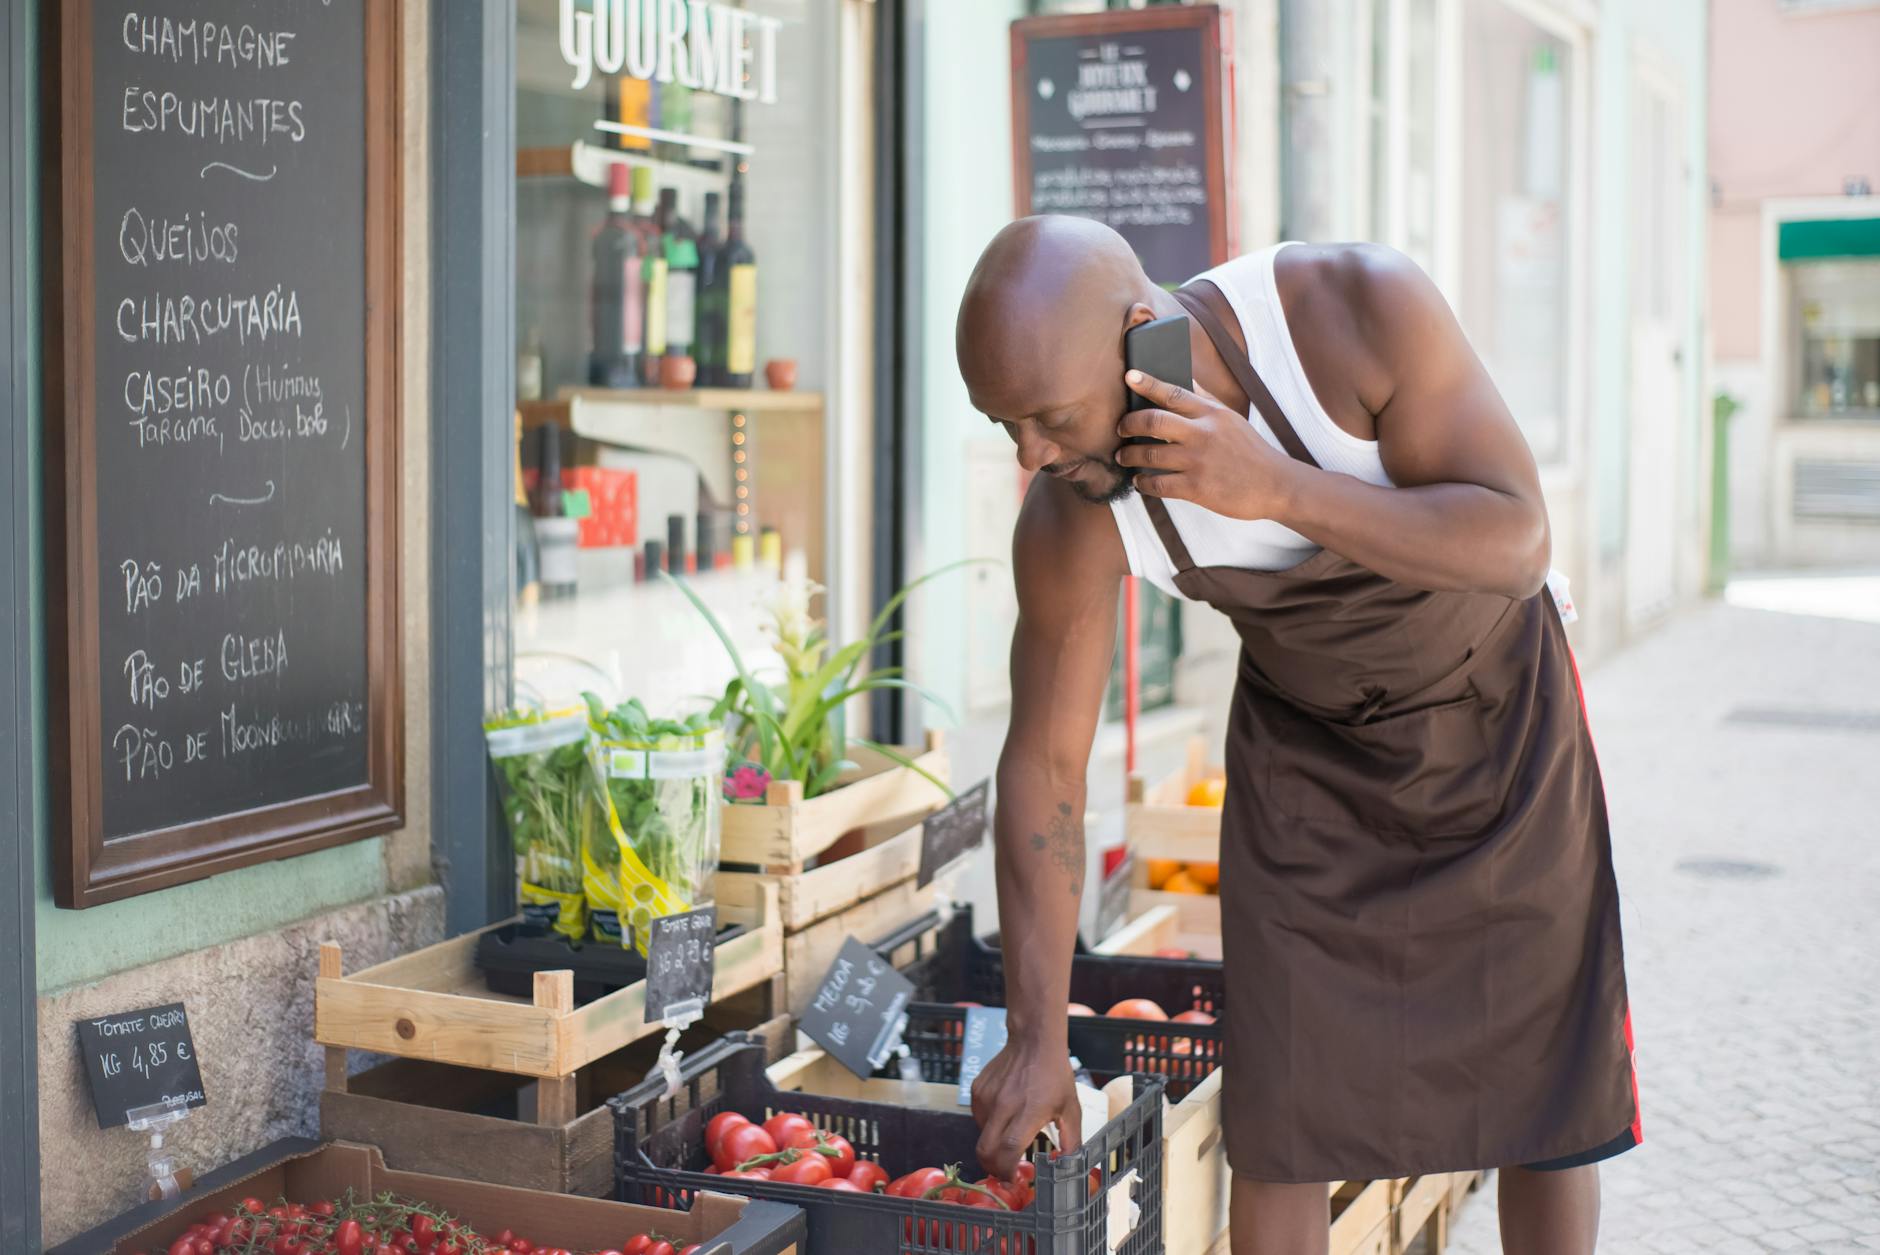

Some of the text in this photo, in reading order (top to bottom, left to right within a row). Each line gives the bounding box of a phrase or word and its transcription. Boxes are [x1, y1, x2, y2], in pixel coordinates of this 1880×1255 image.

[123, 12, 296, 68] CHAMPAGNE
[123, 87, 305, 145] ESPUMANTES
[176, 563, 200, 602] DA
[178, 658, 205, 694] DE
[113, 723, 173, 782] PÃO
[184, 730, 209, 764] DE
[92, 1018, 147, 1037] TOMATE
[100, 1041, 191, 1080] KG 4,85 €
